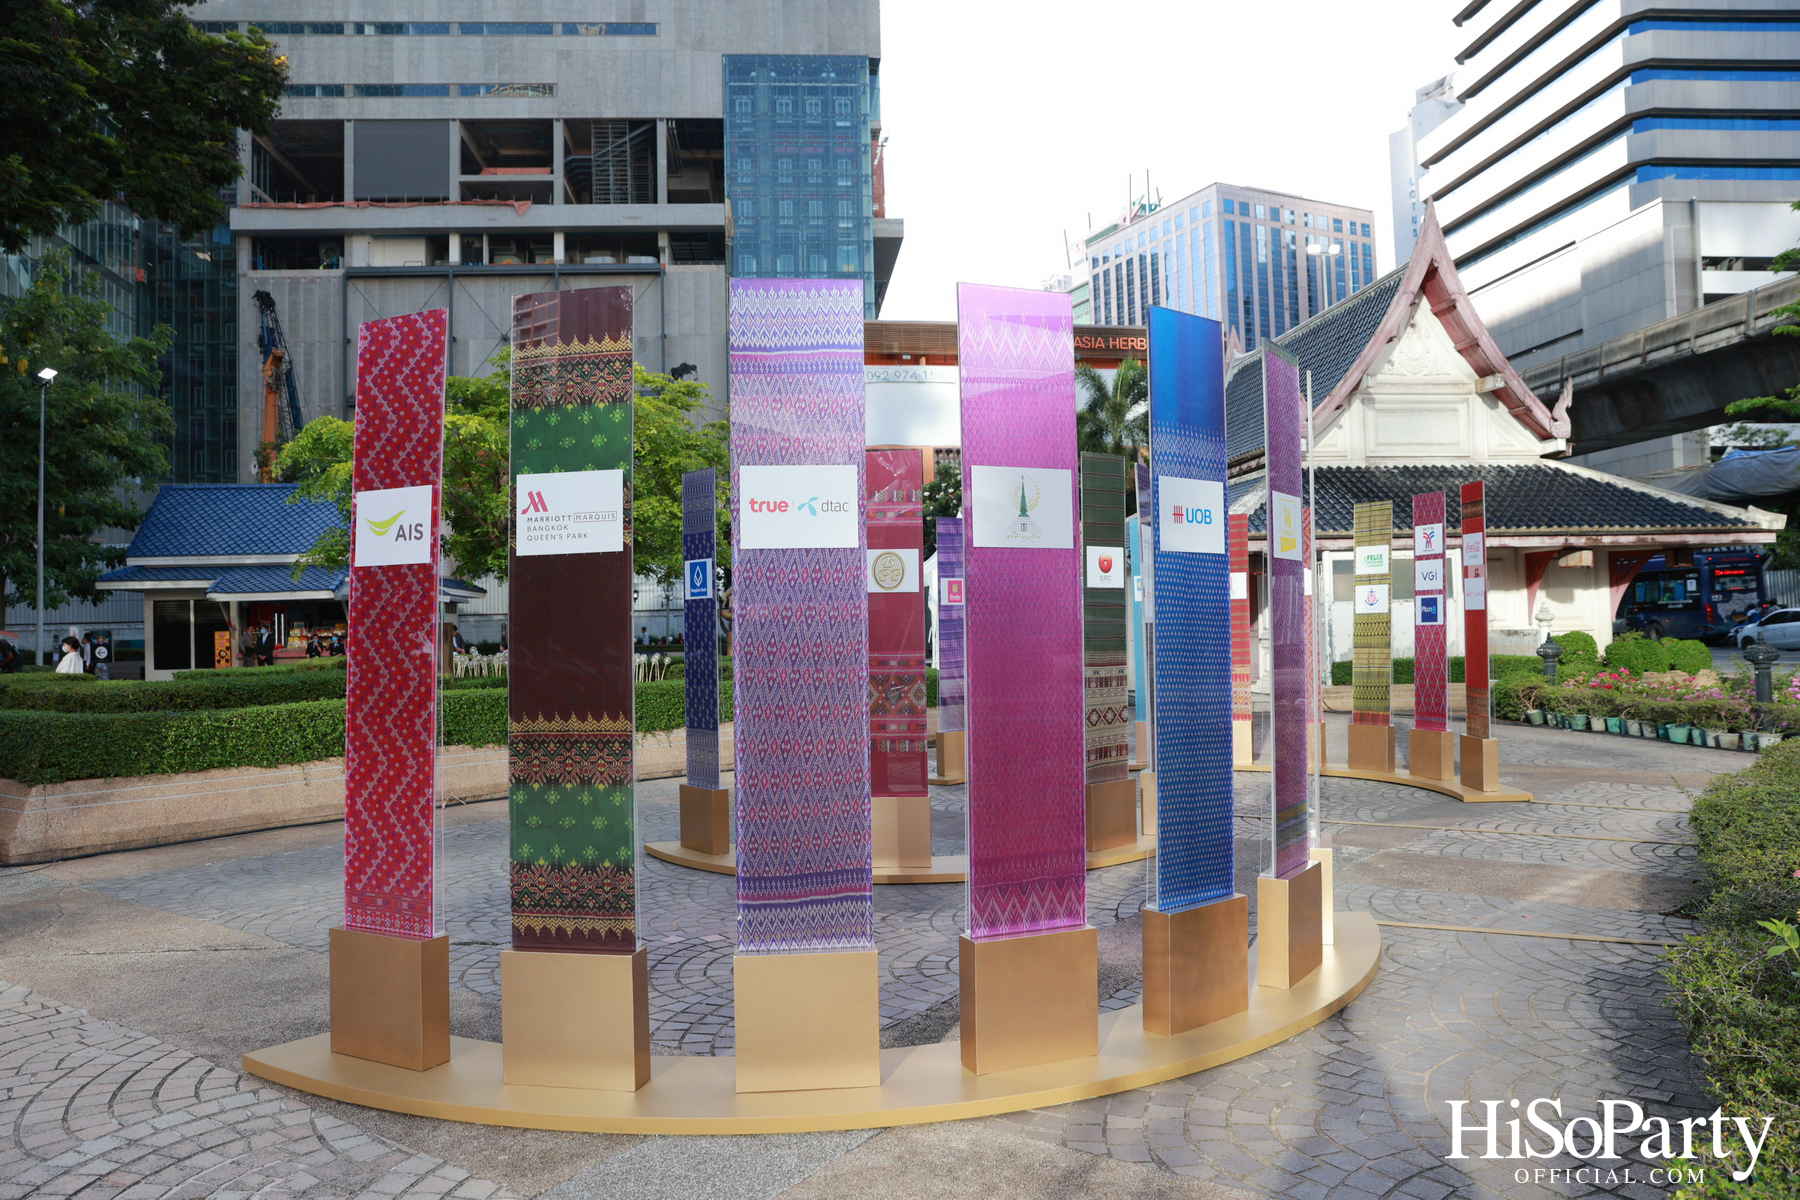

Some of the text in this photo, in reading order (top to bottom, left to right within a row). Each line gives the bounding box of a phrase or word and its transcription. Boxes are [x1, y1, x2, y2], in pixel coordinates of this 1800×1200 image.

[1074, 336, 1147, 350] ASIA HERB
[866, 370, 889, 380] 092
[893, 370, 918, 380] 974
[749, 498, 850, 513] true dtac
[526, 512, 617, 523] MARRIOTT MARQUIS
[1186, 507, 1213, 525] UOB
[395, 523, 424, 542] AIS
[526, 524, 569, 532] BANGKOK
[526, 532, 589, 541] QUEEN'S PARK
